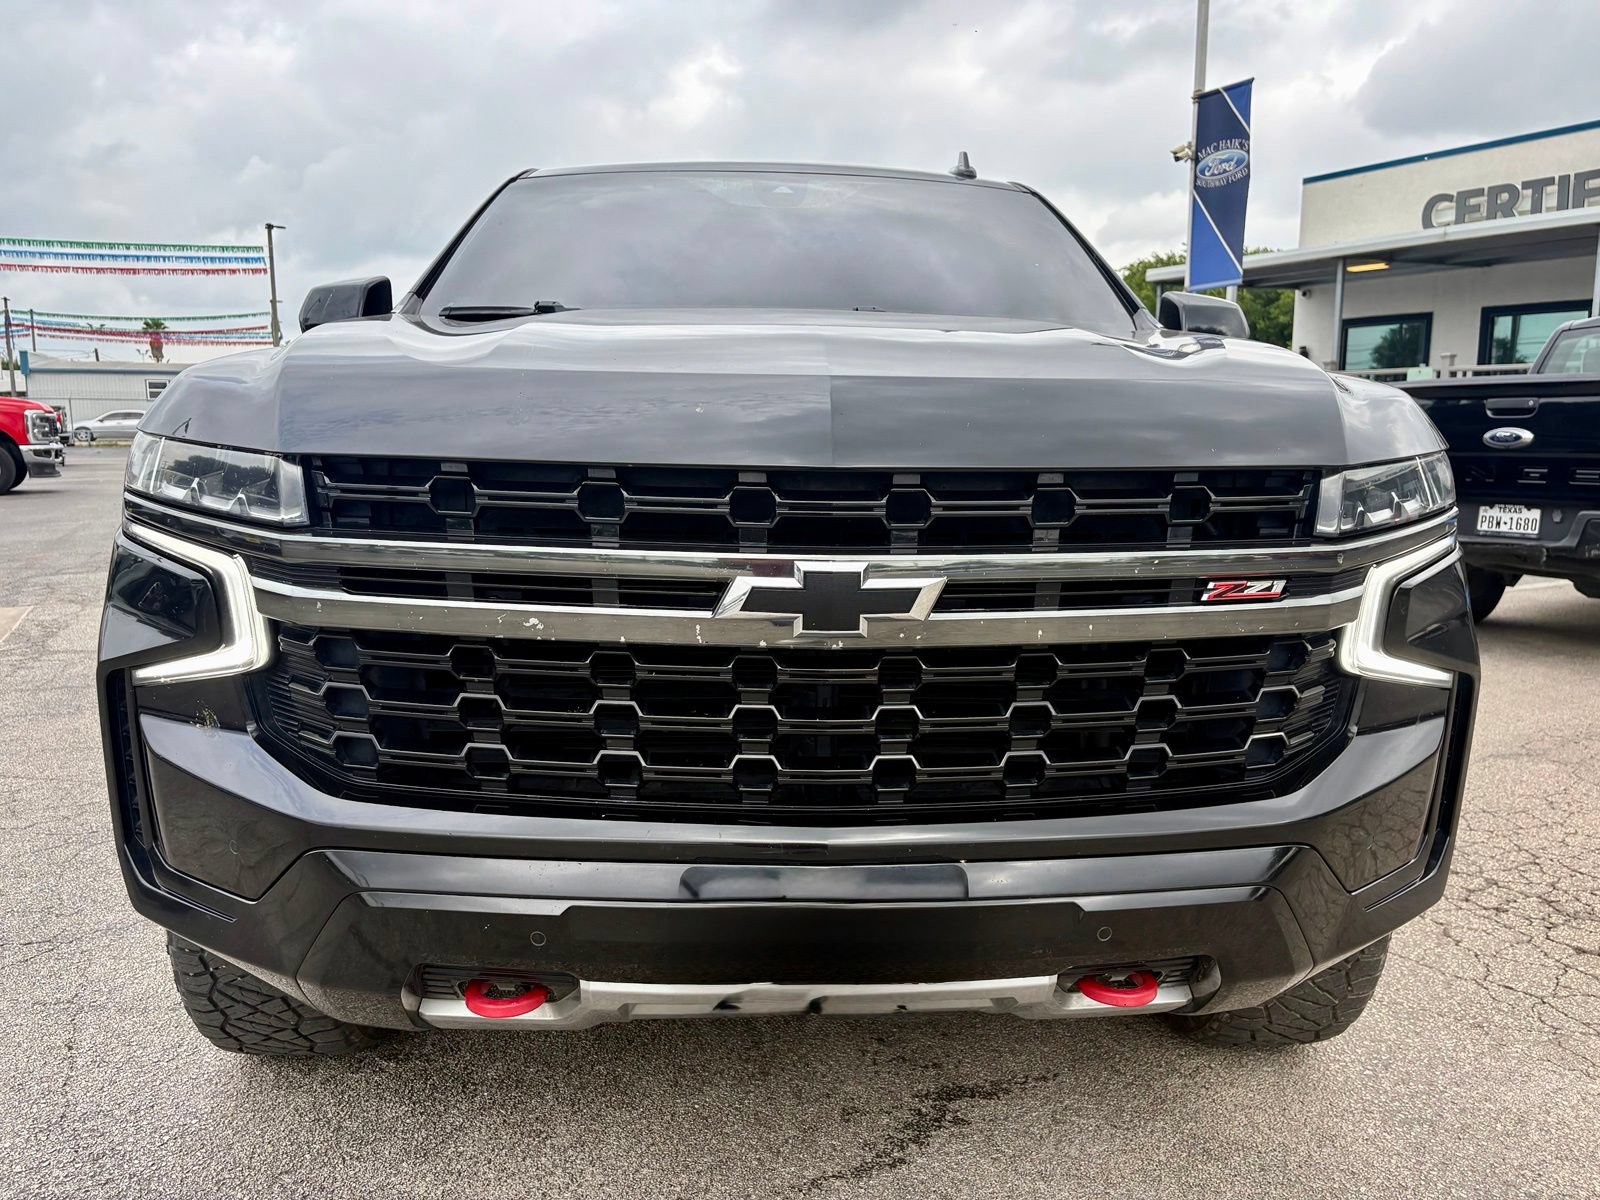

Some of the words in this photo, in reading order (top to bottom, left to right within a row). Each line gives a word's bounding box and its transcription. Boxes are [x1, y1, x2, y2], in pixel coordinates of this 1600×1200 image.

[1198, 142, 1217, 160] MAC
[1204, 156, 1238, 176] Ford
[1228, 168, 1248, 183] FORD
[1498, 506, 1523, 514] TEXAS
[1201, 580, 1287, 601] Z71
